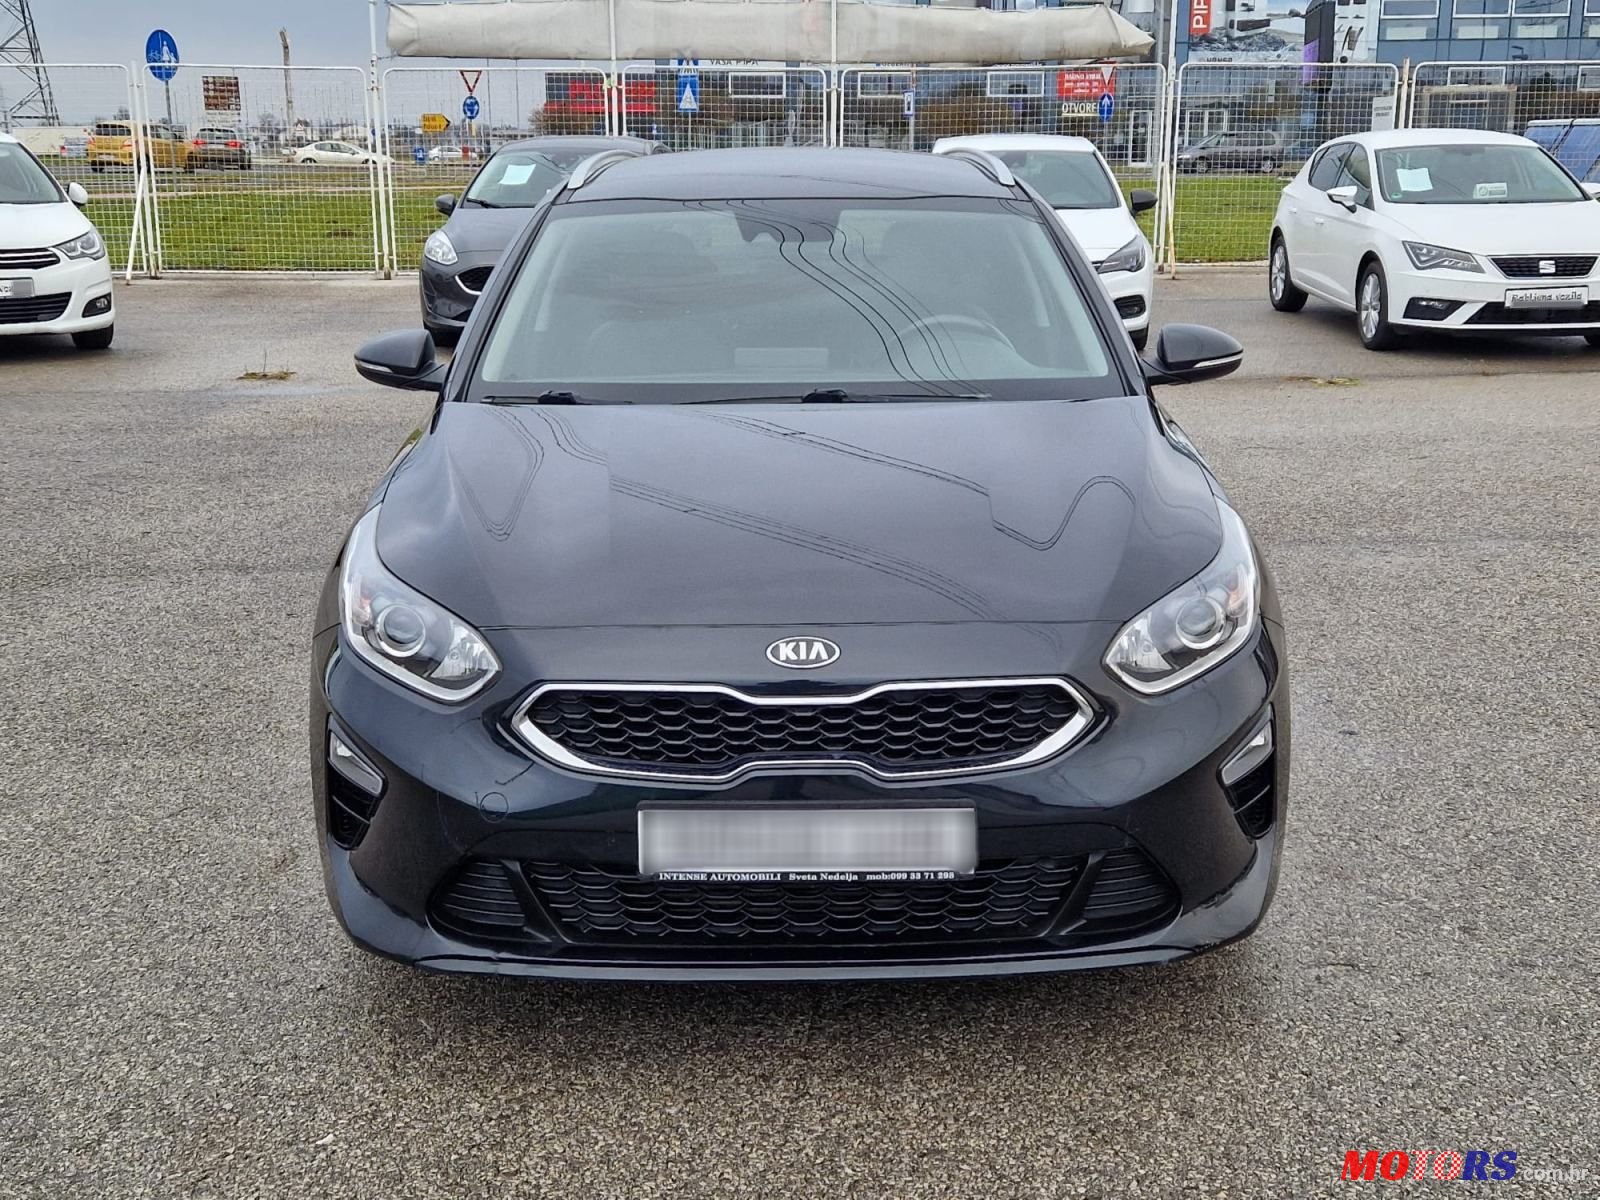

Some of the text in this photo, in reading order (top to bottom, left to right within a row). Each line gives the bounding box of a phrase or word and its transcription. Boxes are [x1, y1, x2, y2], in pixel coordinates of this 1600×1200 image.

[1062, 103, 1097, 113] OTVORE
[779, 641, 829, 660] KIA
[659, 872, 707, 881] INTENSE
[709, 872, 781, 881] AUTOMOBILI
[789, 873, 817, 881] Sveta
[820, 873, 858, 882] Nedelja
[924, 872, 935, 880] 71
